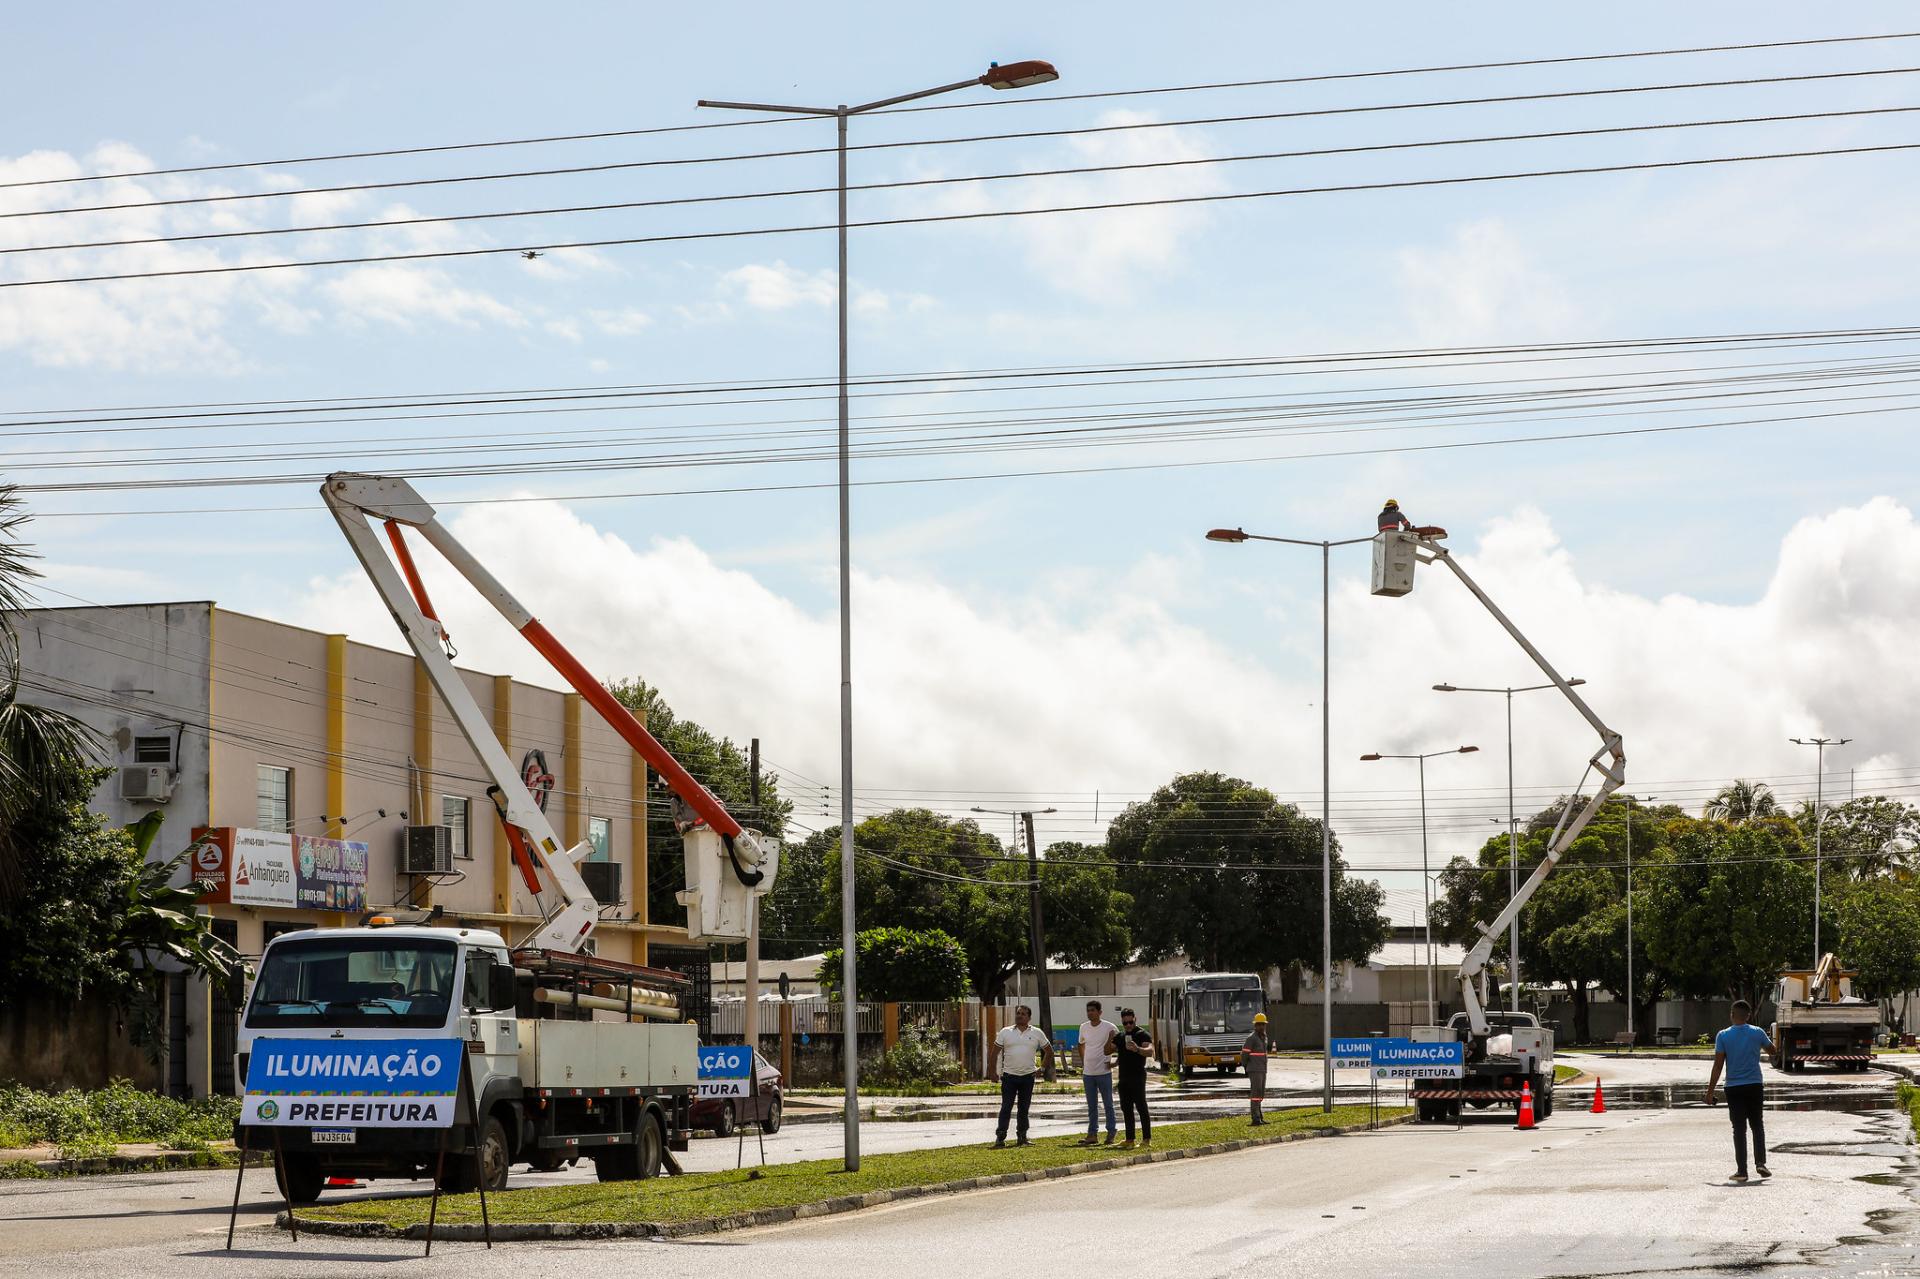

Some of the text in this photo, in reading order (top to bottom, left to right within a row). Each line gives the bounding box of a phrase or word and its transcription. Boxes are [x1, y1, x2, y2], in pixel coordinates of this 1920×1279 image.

[249, 861, 290, 887] Anhanguera
[1378, 1046, 1455, 1061] ILUMINAÇÃO
[266, 1048, 442, 1082] ILUMINAÇÃO
[1391, 1068, 1456, 1078] PREFEITURA
[288, 1103, 438, 1122] PREFEITURA
